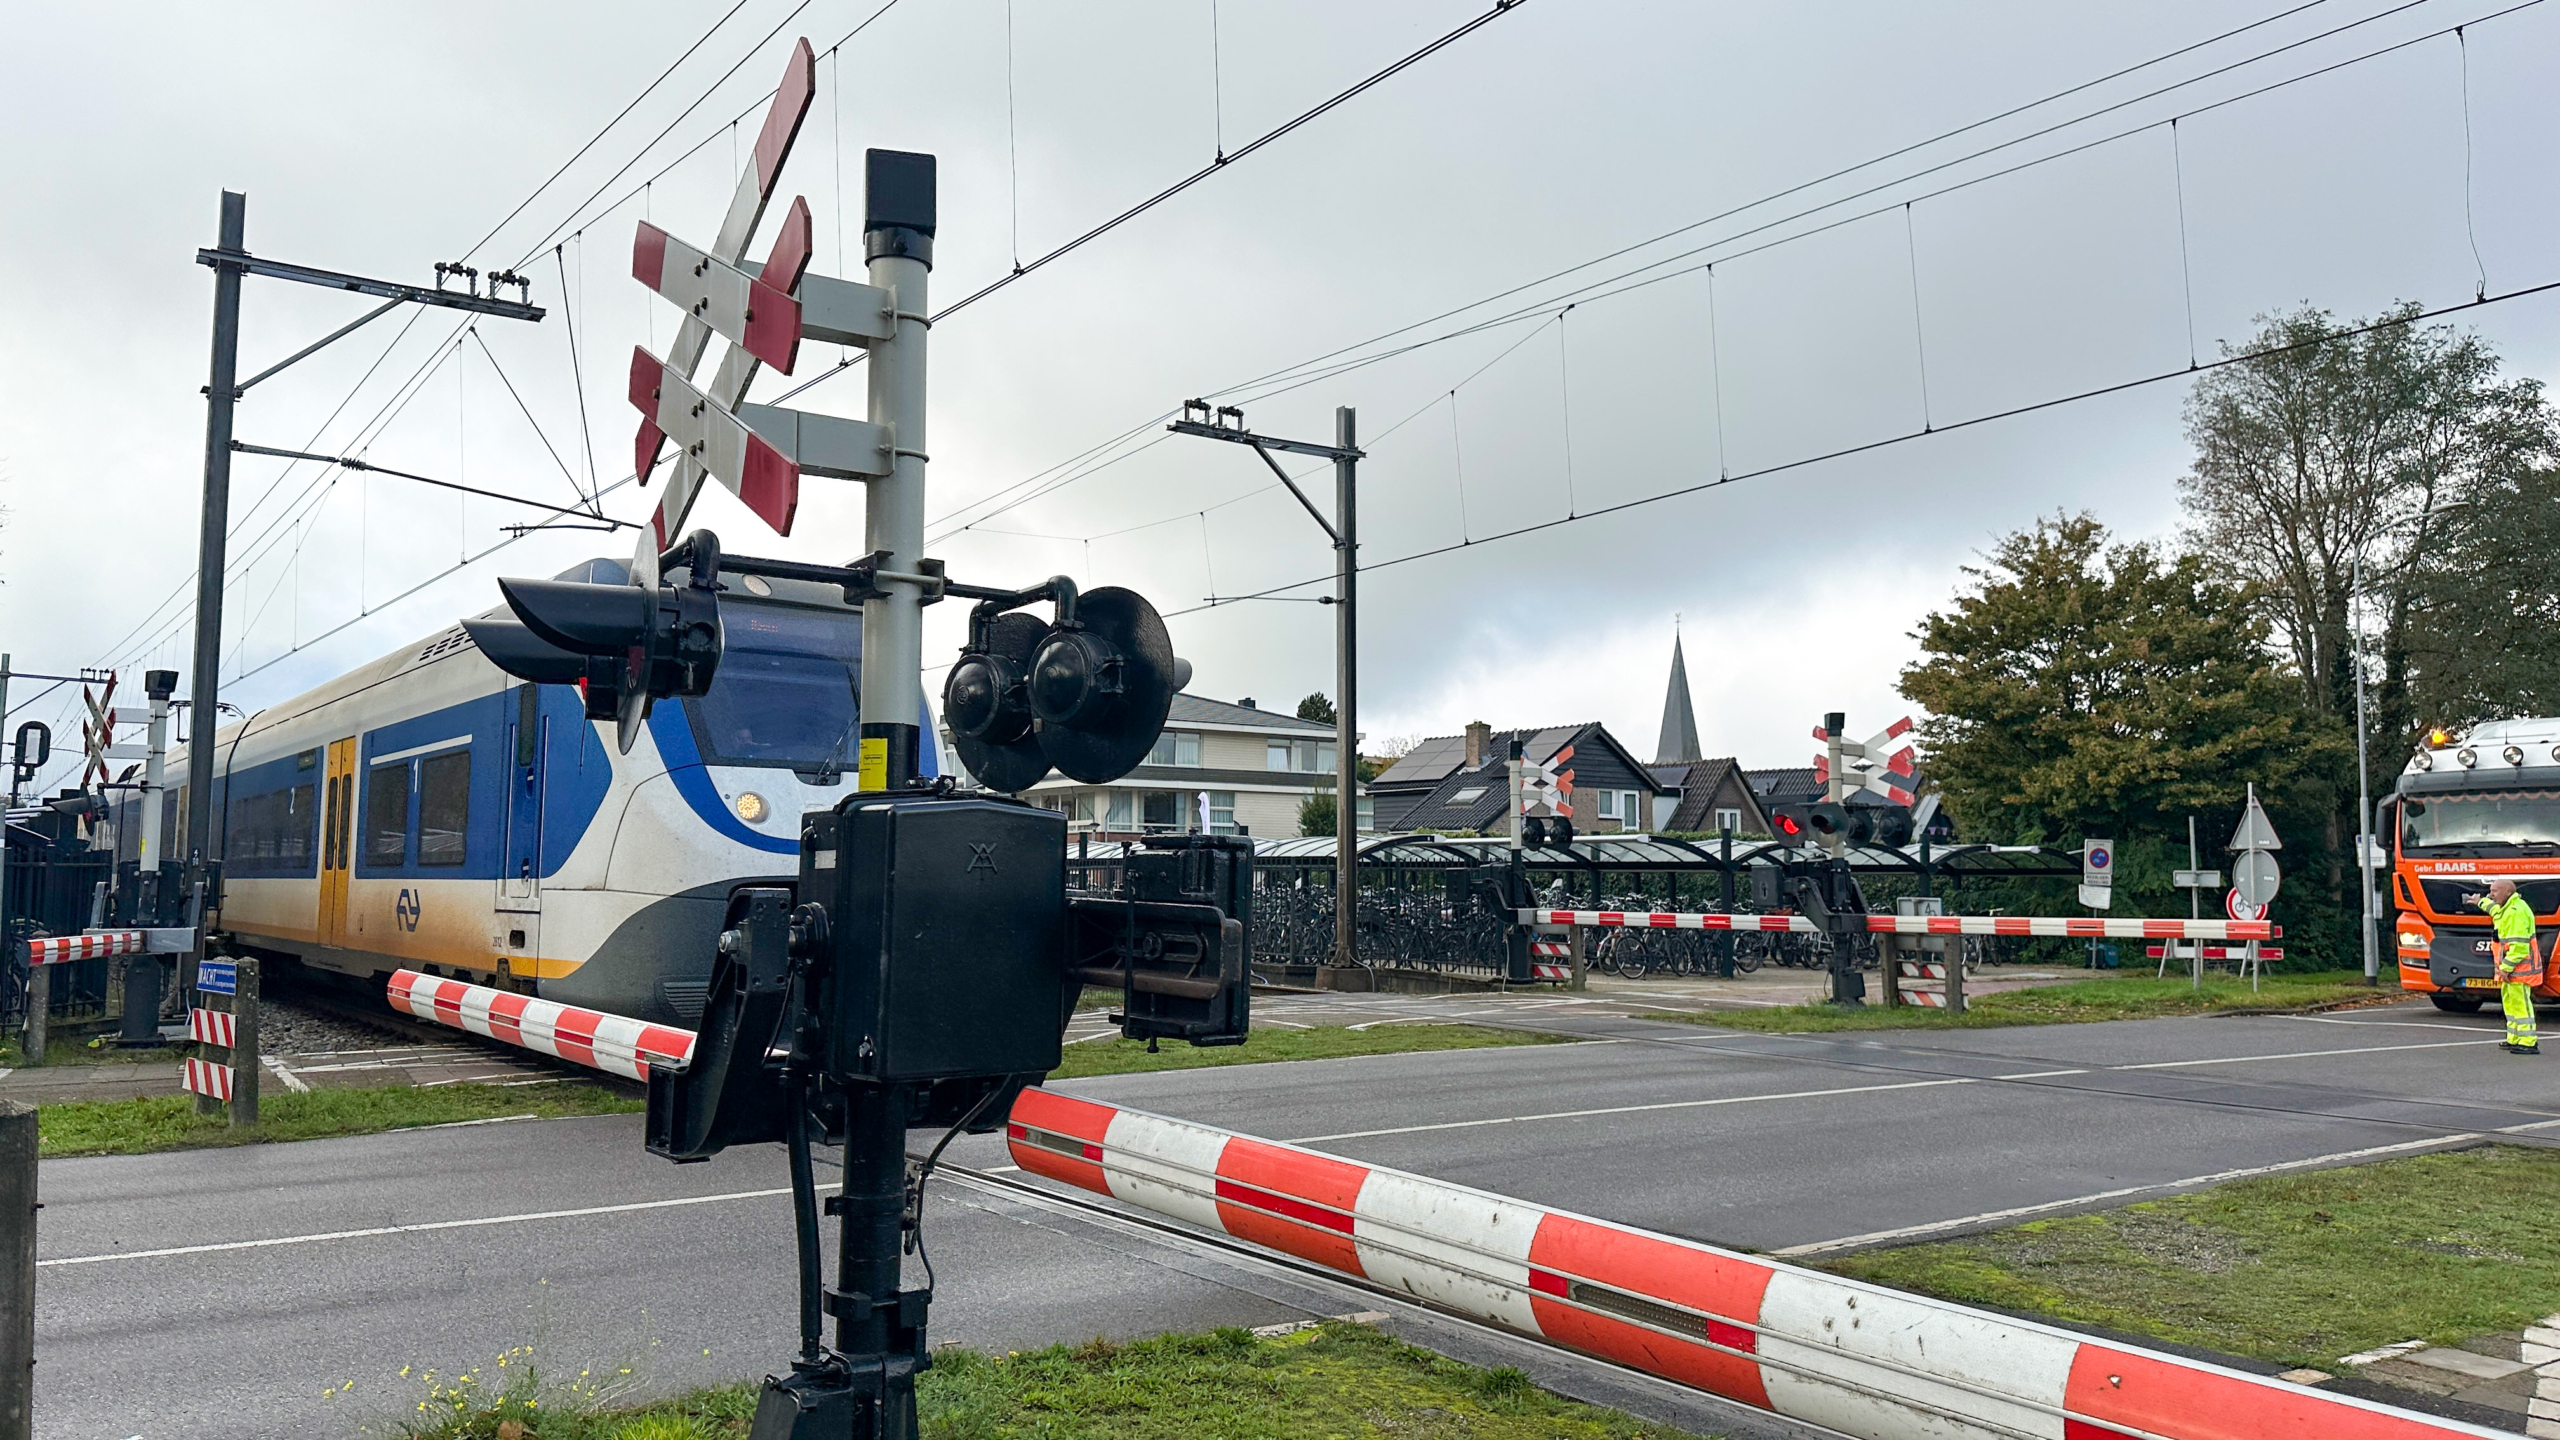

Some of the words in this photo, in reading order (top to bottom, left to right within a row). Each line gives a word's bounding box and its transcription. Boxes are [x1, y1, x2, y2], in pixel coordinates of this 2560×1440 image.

[413, 757, 419, 794] 1
[2434, 862, 2476, 873] BAARS
[2478, 863, 2511, 871] Transport
